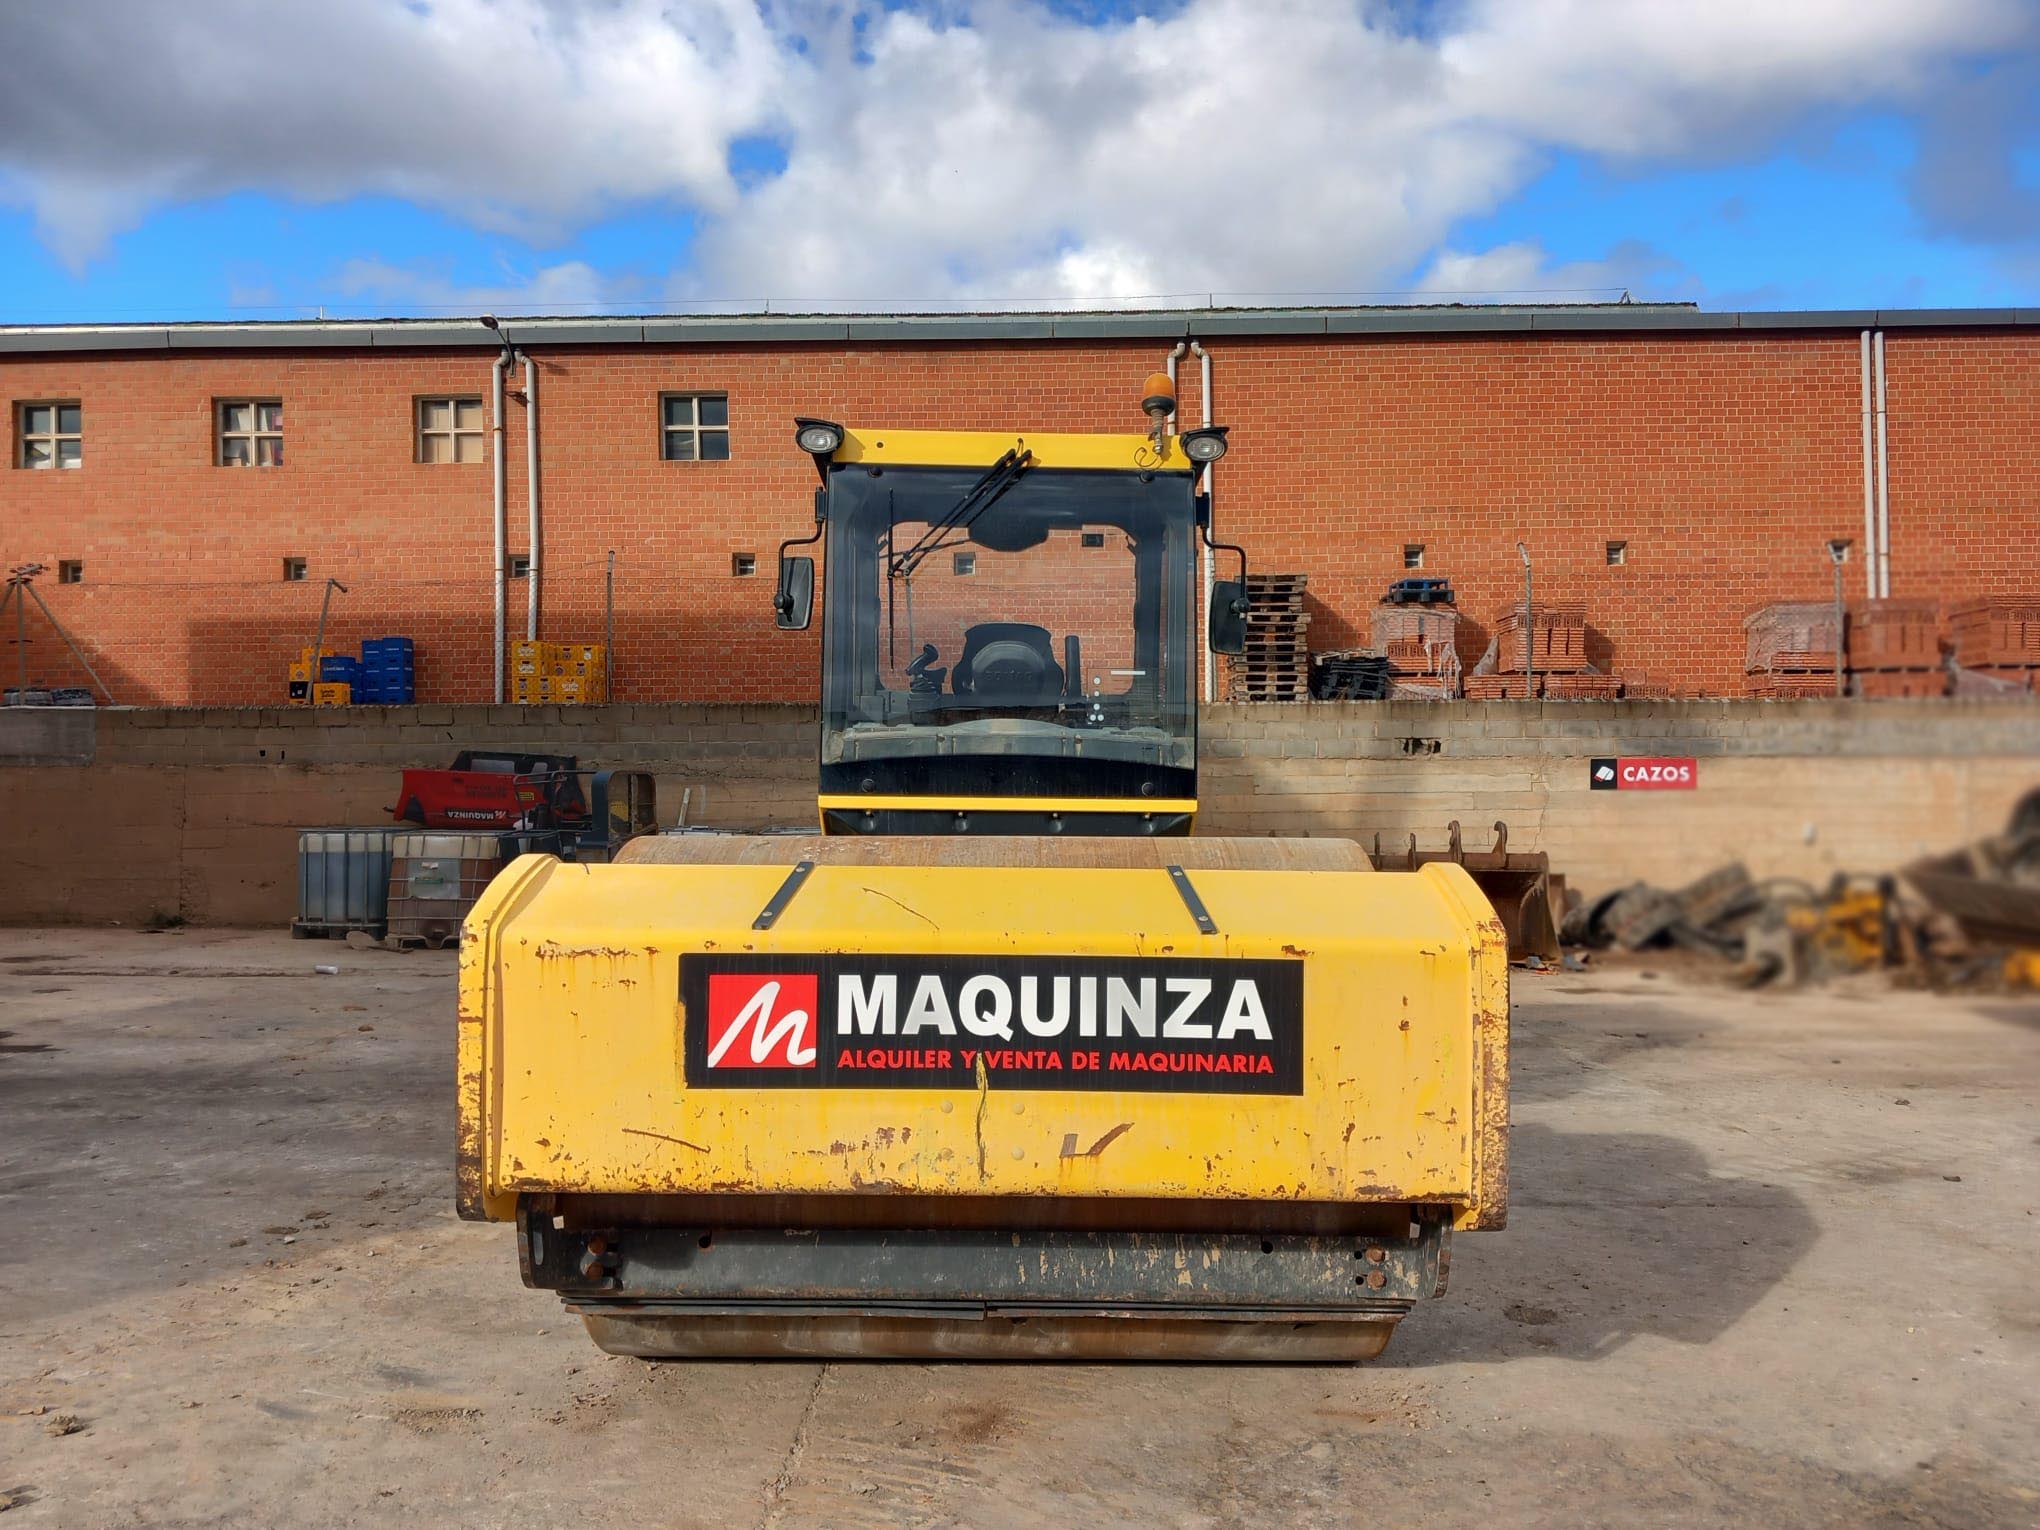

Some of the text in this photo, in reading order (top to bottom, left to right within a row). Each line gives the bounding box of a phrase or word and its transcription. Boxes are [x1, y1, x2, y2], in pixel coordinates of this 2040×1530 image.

[1623, 766, 1690, 782] CAZOS
[447, 811, 494, 819] MAQUINZA
[837, 974, 1274, 1042] MAQUINZA
[837, 1049, 1274, 1074] ALQUILER Y VENTA DE MAQUINARIA
